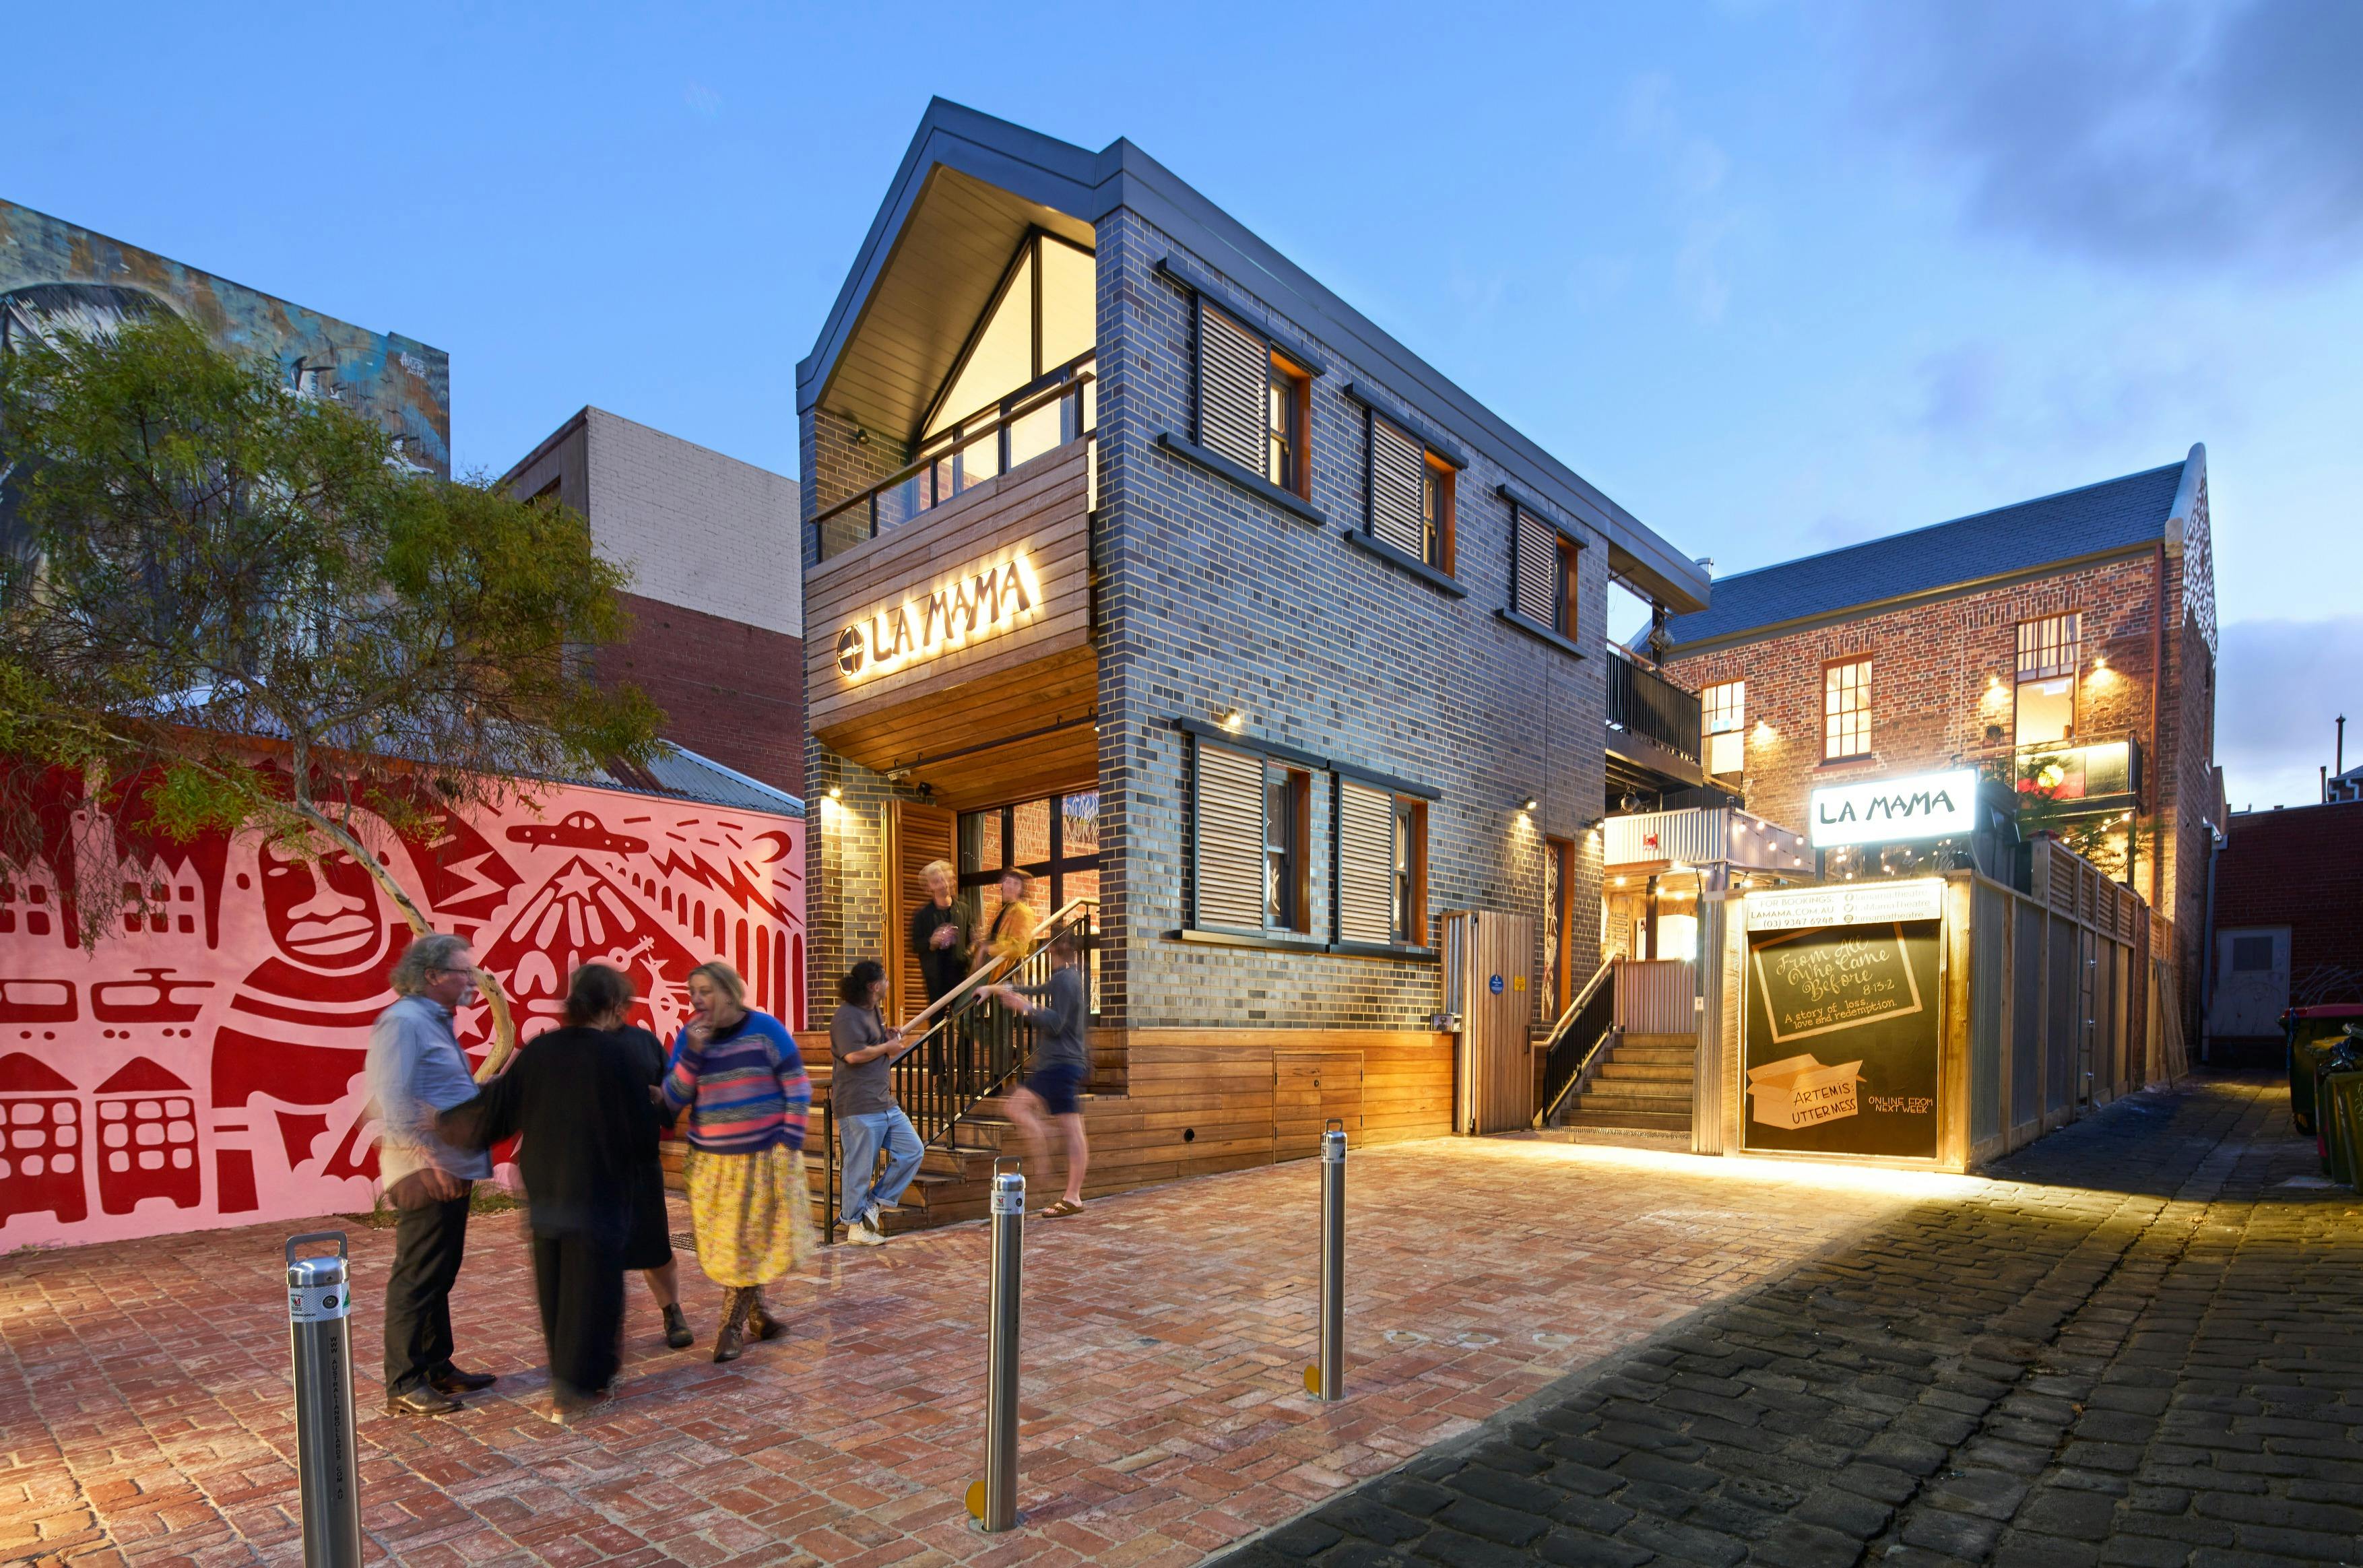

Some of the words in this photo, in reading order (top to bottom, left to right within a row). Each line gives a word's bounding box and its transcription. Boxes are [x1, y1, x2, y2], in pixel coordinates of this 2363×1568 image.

[872, 608, 914, 661] LA
[924, 561, 1031, 647] MAMA
[1820, 801, 1856, 824] LA
[1865, 789, 1955, 820] MAMA
[1751, 907, 1834, 919] LAMAMA.COM.AU
[1761, 899, 1778, 907] FOR
[1782, 896, 1834, 906] BOOKINGS:
[1763, 920, 1781, 928] (03)
[1784, 918, 1807, 926] 9347
[1810, 917, 1834, 925] 6948
[1776, 950, 1830, 975] From
[1835, 936, 1869, 958] All
[1788, 964, 1834, 985] Who
[1836, 949, 1890, 971] Came
[1803, 970, 1873, 1002] Before
[1784, 1014, 1793, 1024] A
[1796, 1008, 1823, 1020] story
[1827, 1002, 1838, 1014] of
[1793, 1019, 1813, 1029] love
[1815, 1014, 1832, 1024] and
[1835, 998, 1897, 1020] redemption.
[1869, 1097, 1904, 1105] ONLINE
[1908, 1097, 1933, 1107] FROM
[1875, 1104, 1900, 1112] NEXT
[1902, 1105, 1928, 1114] WEEK
